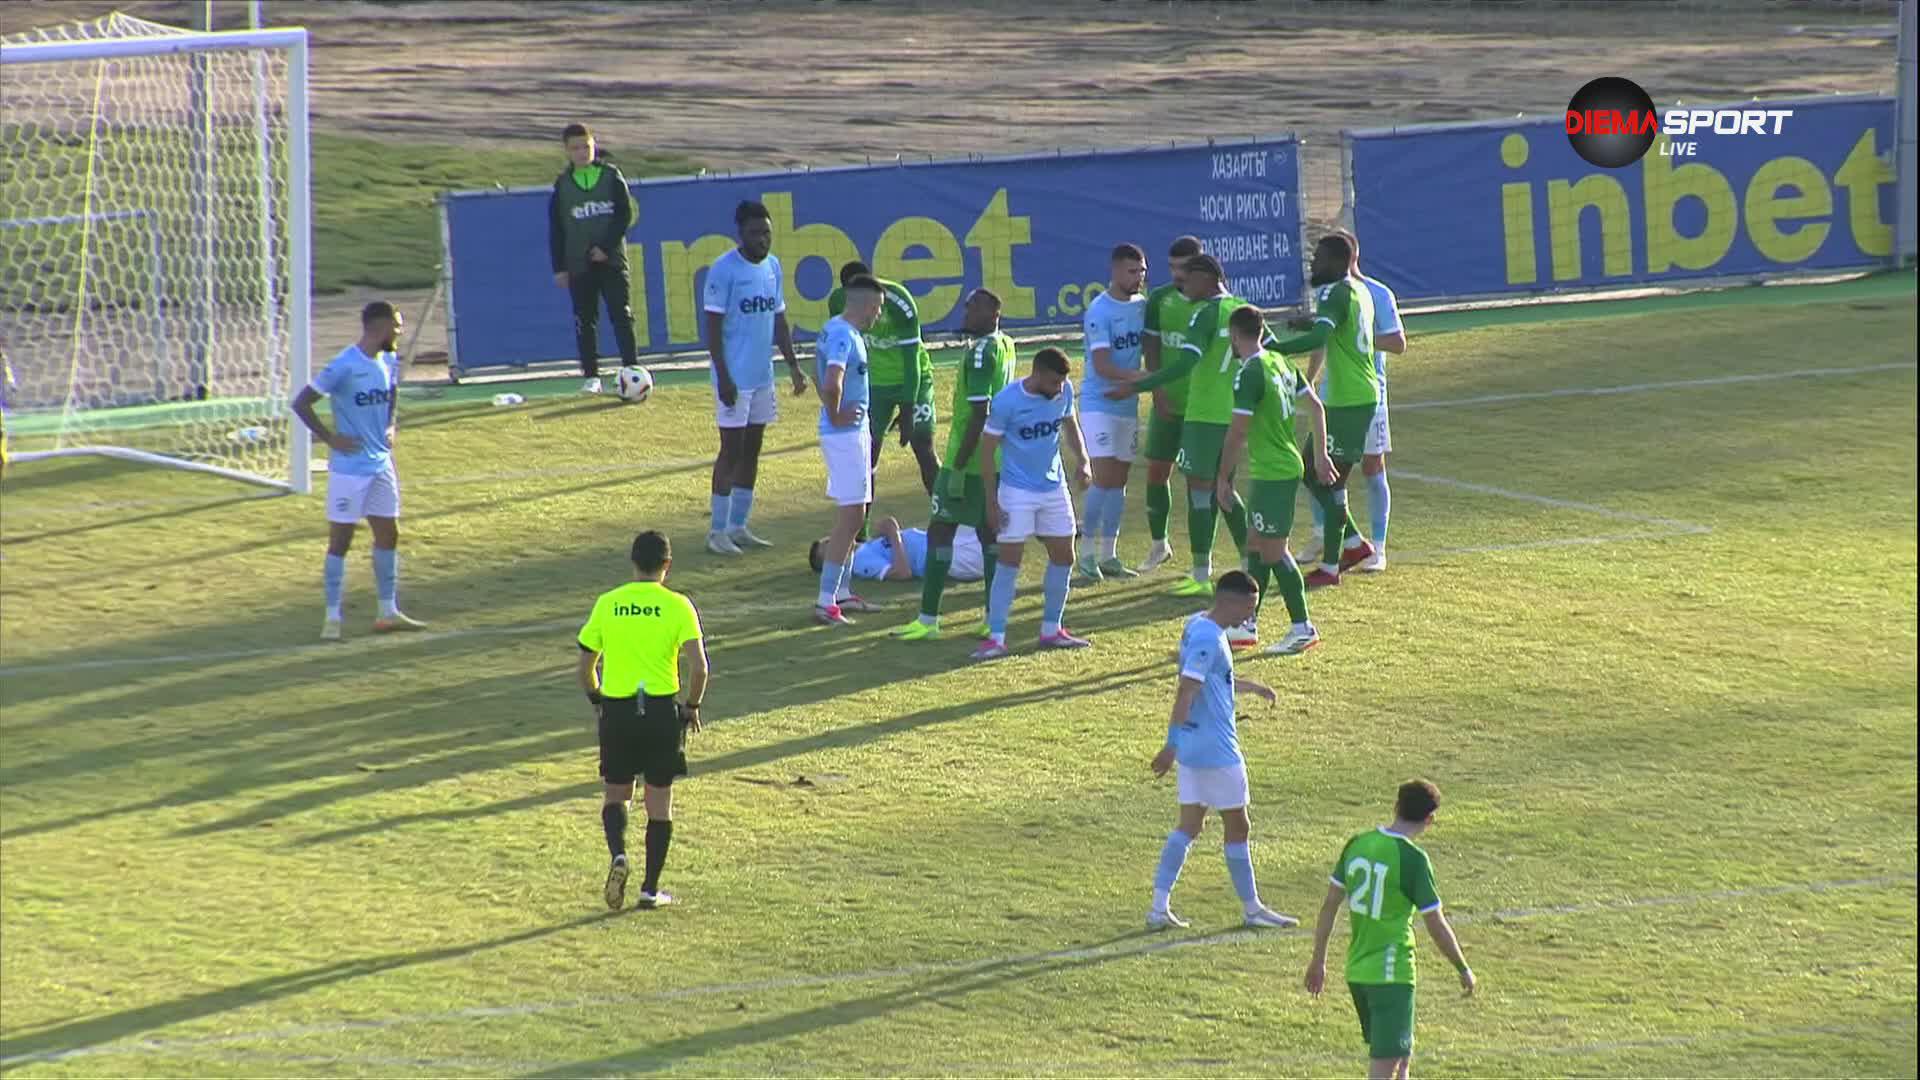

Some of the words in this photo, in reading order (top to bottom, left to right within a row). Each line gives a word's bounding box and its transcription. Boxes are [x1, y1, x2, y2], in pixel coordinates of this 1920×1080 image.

[1200, 194, 1233, 222] НОСИ
[1236, 192, 1267, 220] РИСК
[1271, 191, 1286, 217] ОТ
[1501, 128, 1897, 284] inbet
[1273, 233, 1291, 258] НА
[740, 295, 775, 314] efbe
[913, 403, 932, 423] 29
[614, 601, 661, 618] inbet
[1347, 857, 1389, 921] 21
